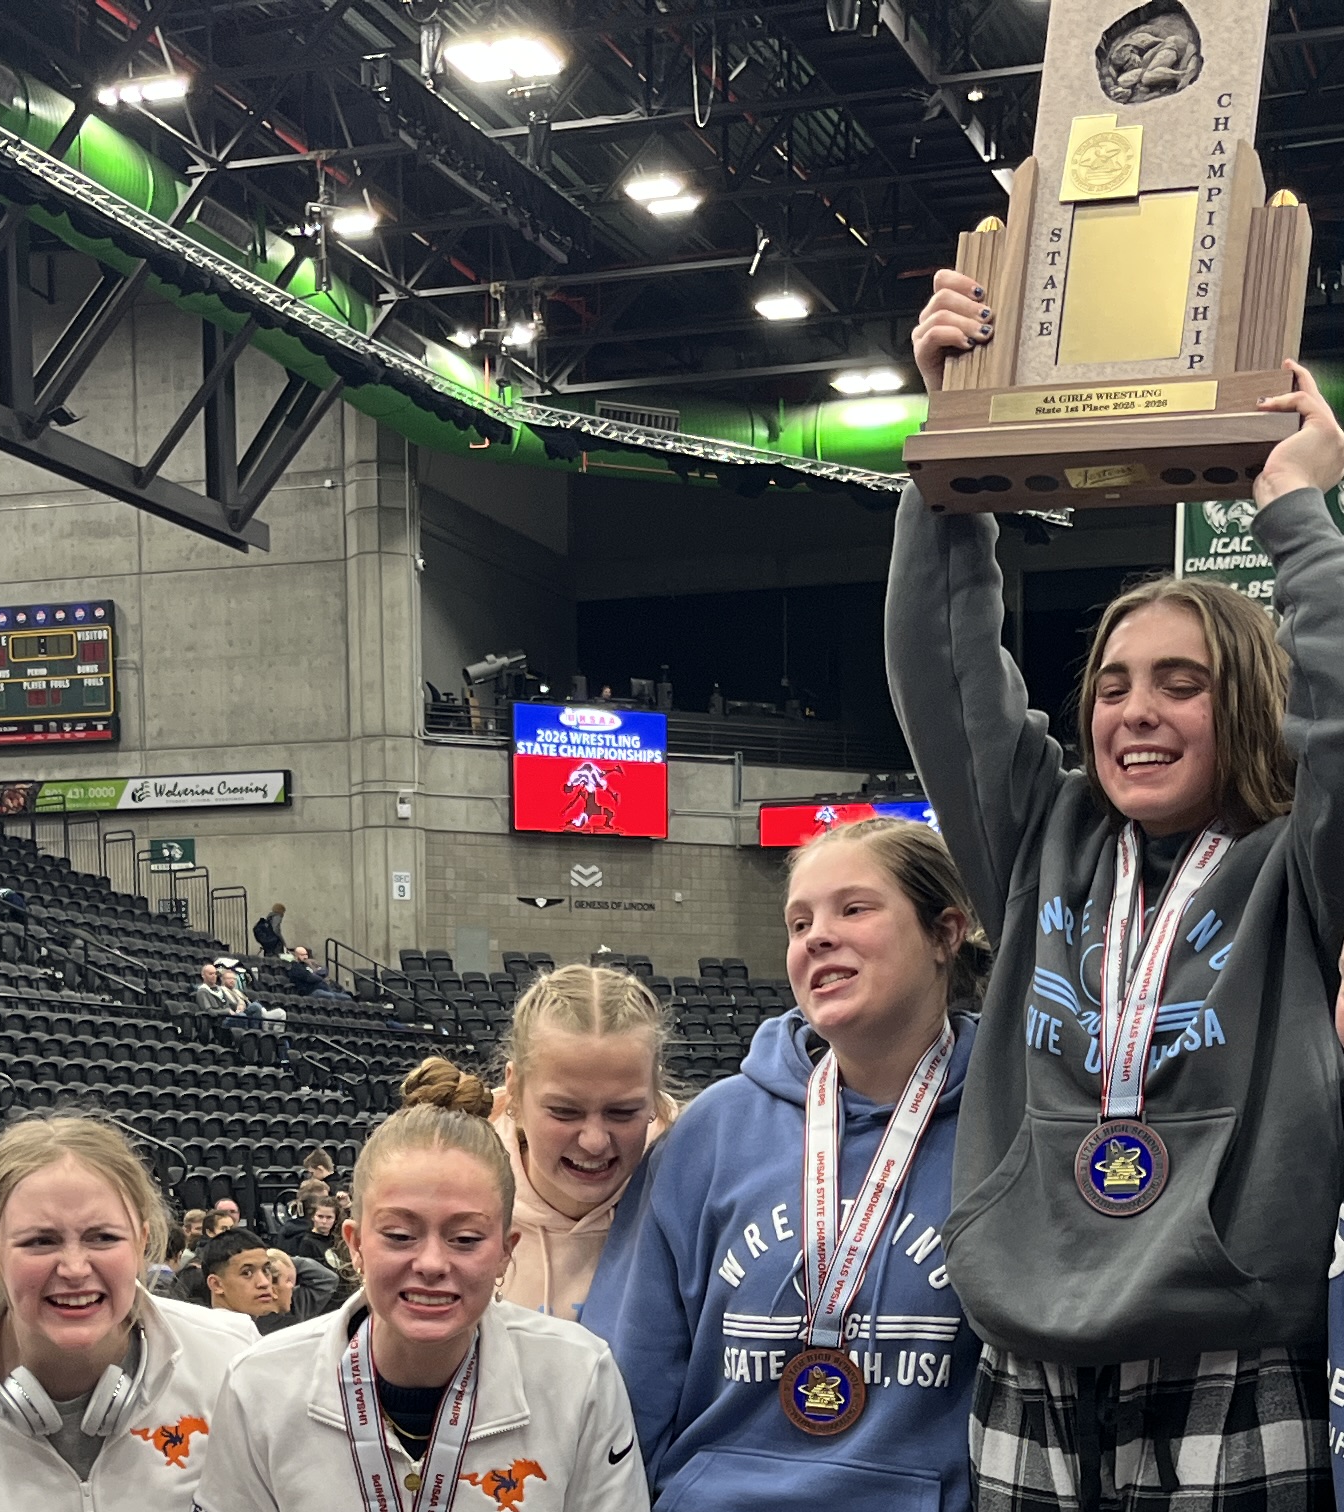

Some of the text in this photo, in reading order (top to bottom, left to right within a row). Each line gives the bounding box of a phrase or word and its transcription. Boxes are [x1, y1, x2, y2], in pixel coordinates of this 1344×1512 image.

[1187, 93, 1232, 370] CHAMPIONSHIP
[1037, 227, 1063, 337] STATE
[1059, 393, 1093, 403] GIRLS
[1096, 389, 1161, 400] WRESTLING
[1035, 406, 1061, 415] State
[1065, 405, 1078, 413] 1st
[1082, 404, 1109, 412] Place
[1210, 536, 1253, 554] ICAC
[77, 630, 108, 640] VISITOR
[23, 679, 70, 690] PLAYER FOULS
[84, 678, 104, 687] FOULS
[536, 729, 641, 748] 2026 WRESTLING
[517, 741, 663, 763] STATE CHAMPIONSHIPS
[153, 781, 268, 799] Wolverine Crossing
[1195, 837, 1222, 870] UHSAA
[398, 885, 406, 898] 9
[574, 900, 656, 911] GENESIS OF LINDON
[1121, 908, 1175, 1083] UHSAA STATE CHAMPIONSHIPS
[909, 1056, 942, 1114] UHSAA STATE
[1103, 1124, 1129, 1136] HIGH
[816, 1151, 826, 1219] UHSAA STATE
[826, 1159, 896, 1315] UHSAA STATE CHAMPIONSHIPS
[350, 1351, 362, 1386] STATE
[722, 1346, 952, 1388] STATE USA
[356, 1387, 369, 1426] UHSAA
[433, 1473, 445, 1507] UHSAA
